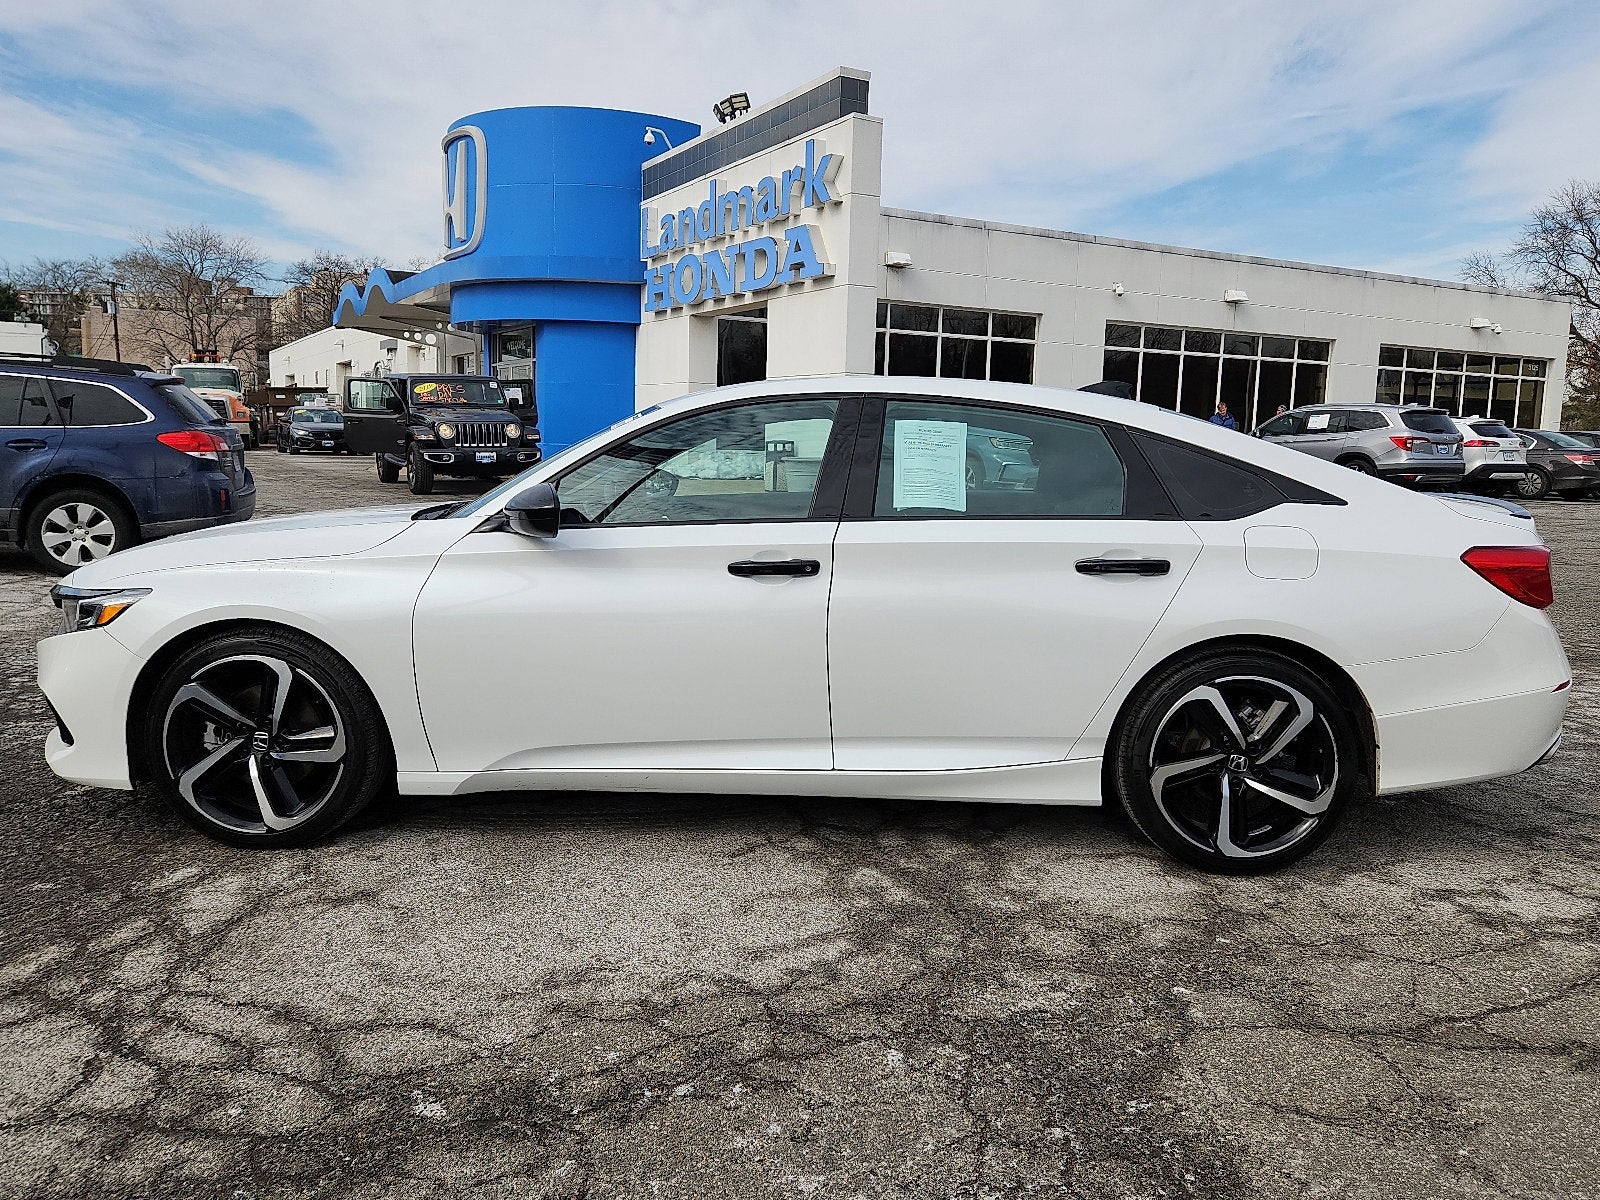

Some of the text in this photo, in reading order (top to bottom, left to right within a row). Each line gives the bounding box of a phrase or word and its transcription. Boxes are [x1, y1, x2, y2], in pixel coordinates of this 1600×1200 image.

[641, 138, 839, 260] Landmark
[643, 223, 829, 312] HONDA
[436, 384, 465, 393] PRES
